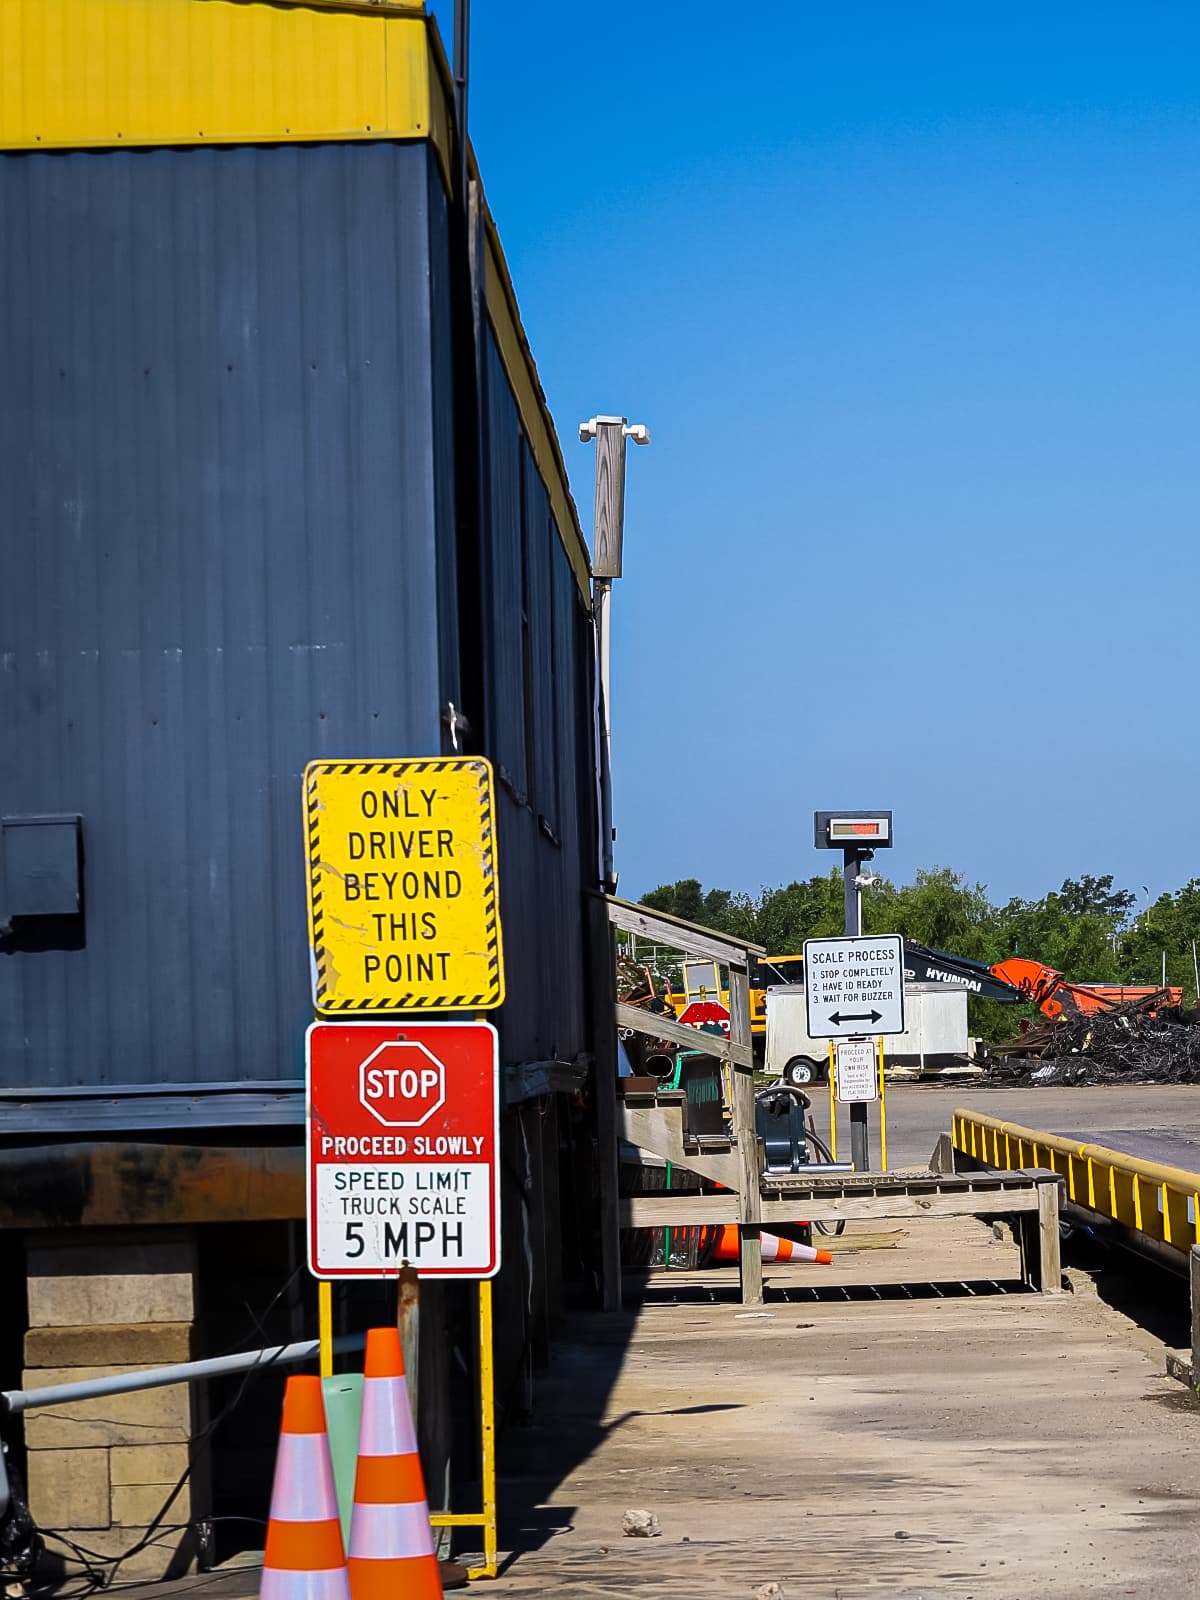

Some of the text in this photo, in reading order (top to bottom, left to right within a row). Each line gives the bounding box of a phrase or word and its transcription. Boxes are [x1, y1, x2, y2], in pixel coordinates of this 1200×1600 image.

[361, 789, 438, 819] ONLY
[348, 829, 455, 861] DRIVER
[344, 870, 462, 902] BEYOND
[371, 911, 437, 942] THIS
[363, 952, 451, 984] POINT
[812, 949, 895, 964] SCALE PROCESS
[820, 969, 840, 979] STOP
[842, 966, 895, 978] COMPLETELY
[822, 981, 843, 991] HAVE
[845, 981, 854, 990] ID
[856, 979, 883, 989] READY
[925, 967, 982, 992] HYUNDAI
[822, 994, 841, 1003] WAIT
[843, 993, 859, 1002] FOR
[861, 991, 893, 1002] BUZZER
[366, 1069, 439, 1099] STOP
[321, 1136, 485, 1156] PROCEED SLOWLY
[334, 1171, 472, 1191] SPEED LIMIT
[340, 1197, 467, 1216] TRUCK SCALE
[345, 1221, 463, 1258] 5 MPH
